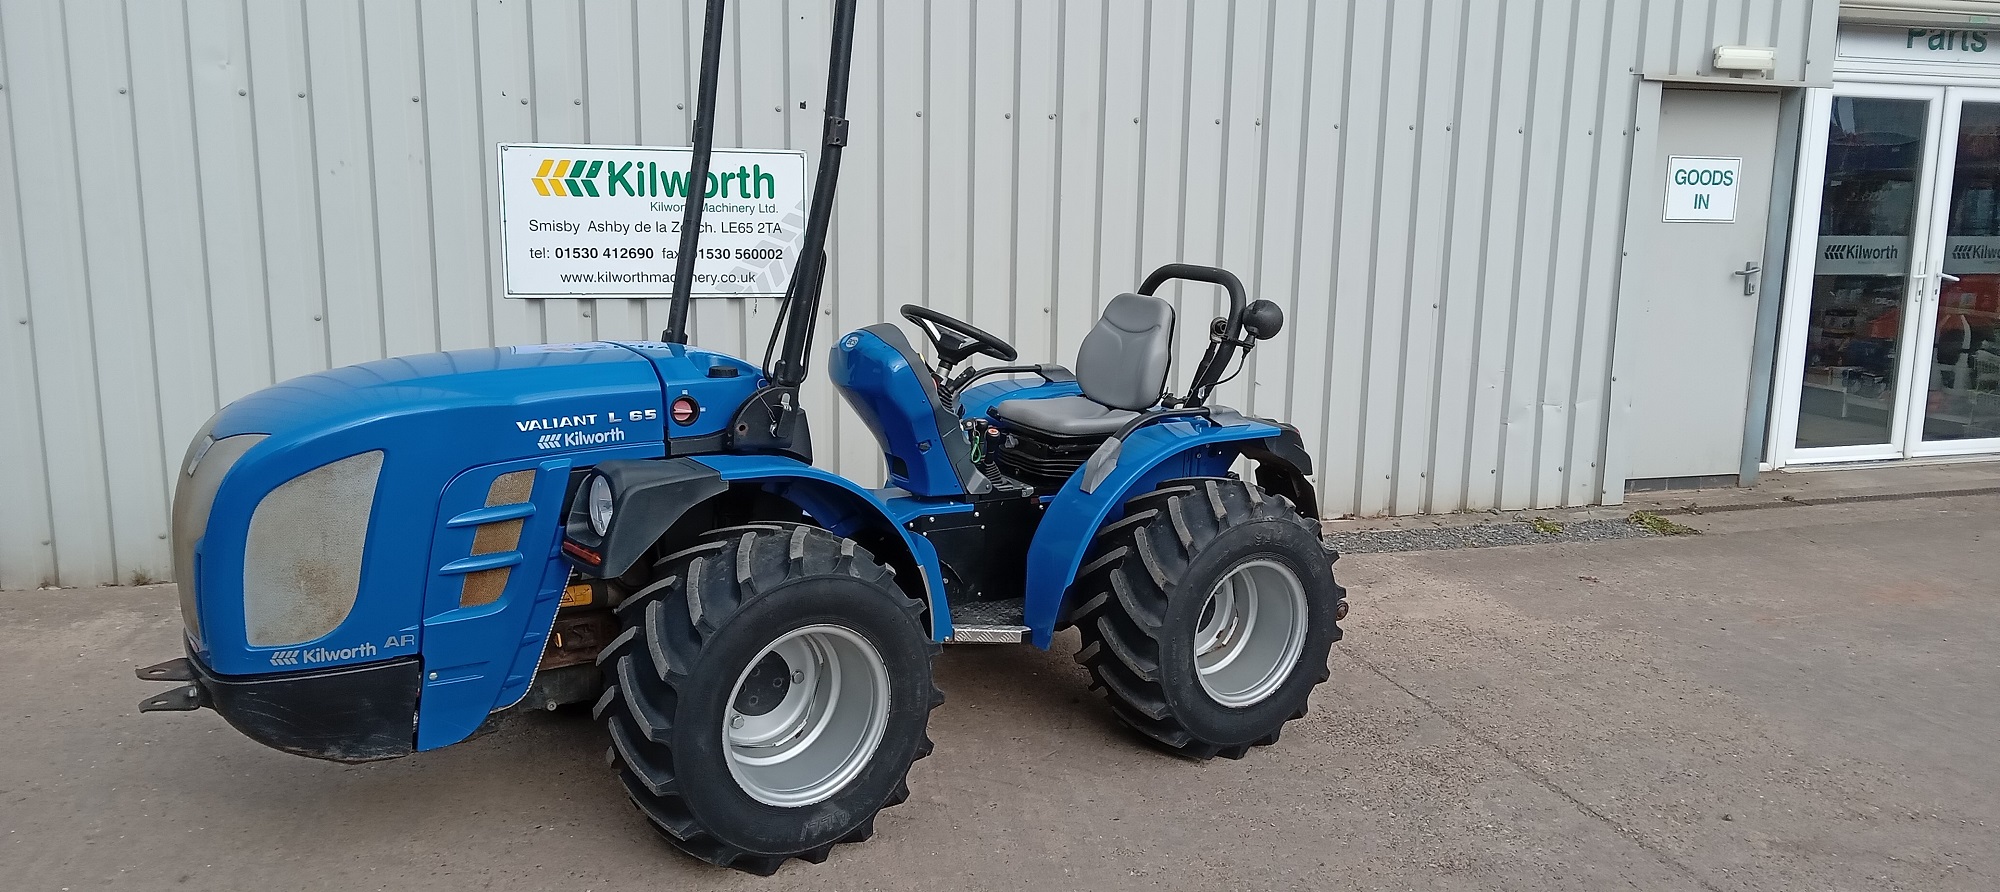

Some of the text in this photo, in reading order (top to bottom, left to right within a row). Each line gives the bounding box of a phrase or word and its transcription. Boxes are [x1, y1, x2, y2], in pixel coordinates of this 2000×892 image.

[1906, 28, 1988, 52] Parts
[608, 160, 775, 199] Kilworth
[1675, 169, 1733, 186] GOODS
[650, 201, 686, 212] Kilwor
[758, 203, 779, 213] Ltd.
[1694, 194, 1710, 209] IN
[529, 219, 783, 235] Smisby Ashby de la Zch. LE65 2TA
[529, 247, 550, 259] tel:
[555, 247, 598, 259] 01530
[602, 247, 654, 259] 412690
[695, 248, 731, 260] 1530
[734, 248, 783, 260] 560002
[1846, 245, 1898, 259] Kilworth
[560, 271, 756, 286] www.kilworthmacnery.co.uk
[516, 409, 657, 432] VALIANT L 65
[564, 427, 625, 447] Kilworth
[383, 634, 415, 648] AR
[303, 642, 377, 664] Kilworth
